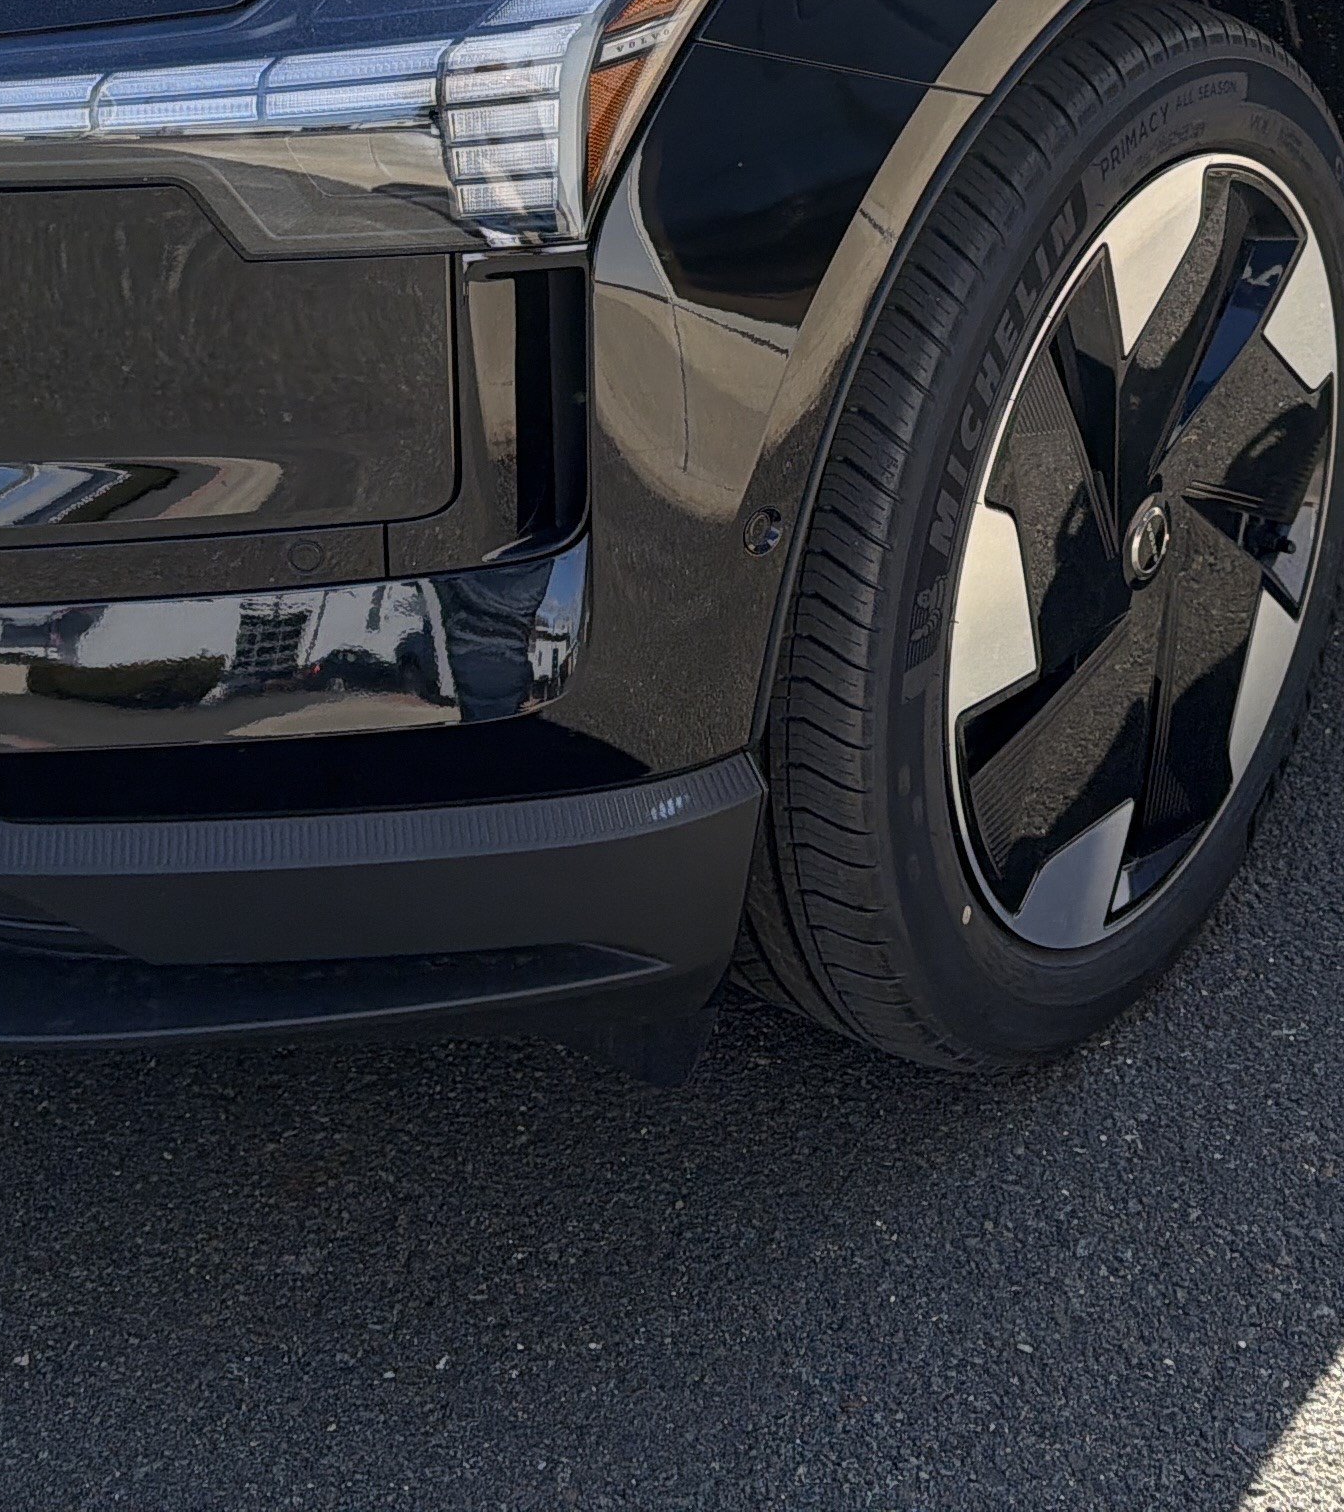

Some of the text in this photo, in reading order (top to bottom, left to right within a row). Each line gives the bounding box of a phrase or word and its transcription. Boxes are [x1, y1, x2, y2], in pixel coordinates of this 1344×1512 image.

[616, 28, 670, 53] VOLVO
[1099, 102, 1168, 180] PRIMACY
[929, 204, 1077, 558] MICHELIN
